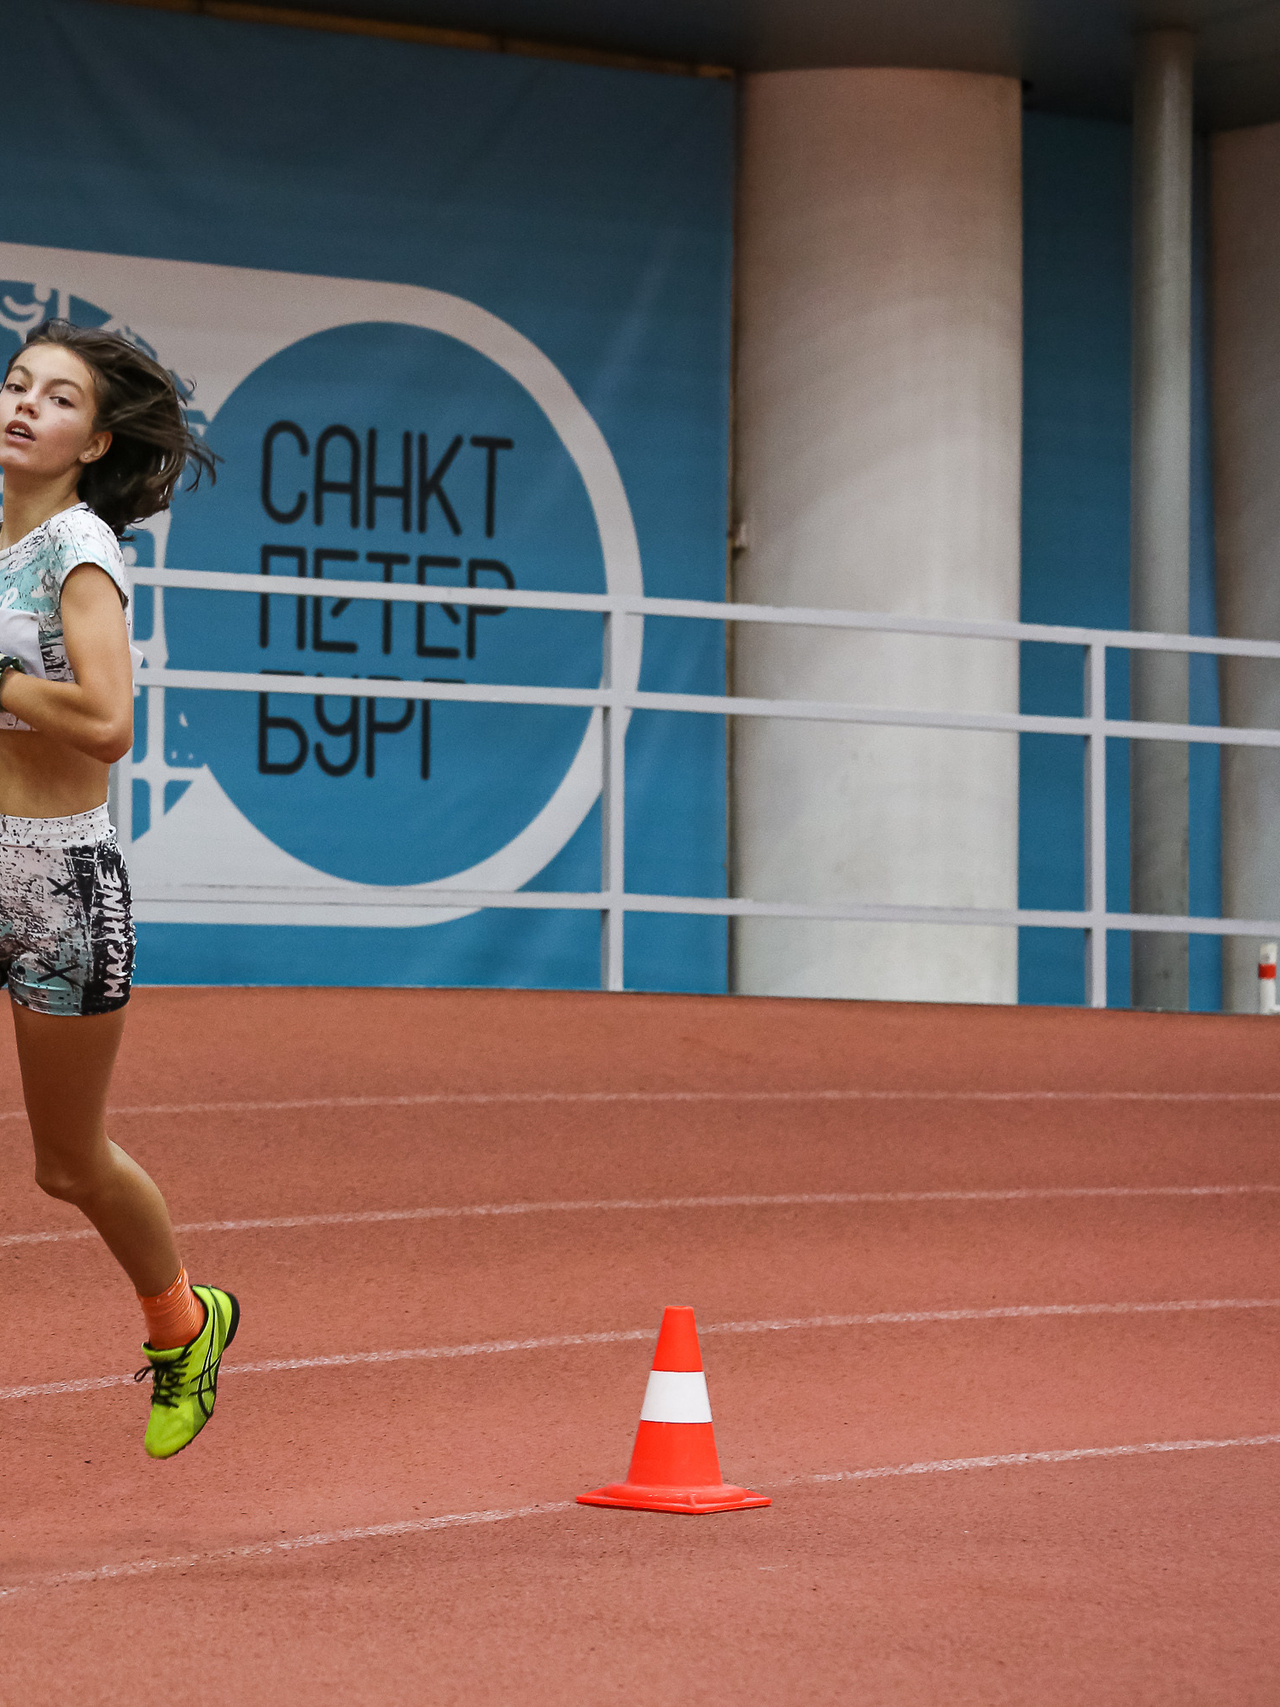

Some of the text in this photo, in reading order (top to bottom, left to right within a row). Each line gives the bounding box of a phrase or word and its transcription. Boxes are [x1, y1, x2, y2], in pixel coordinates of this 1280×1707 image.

[261, 419, 515, 539] САНКТ
[260, 544, 516, 660] ПЕТЕР
[257, 670, 468, 781] БУРГ
